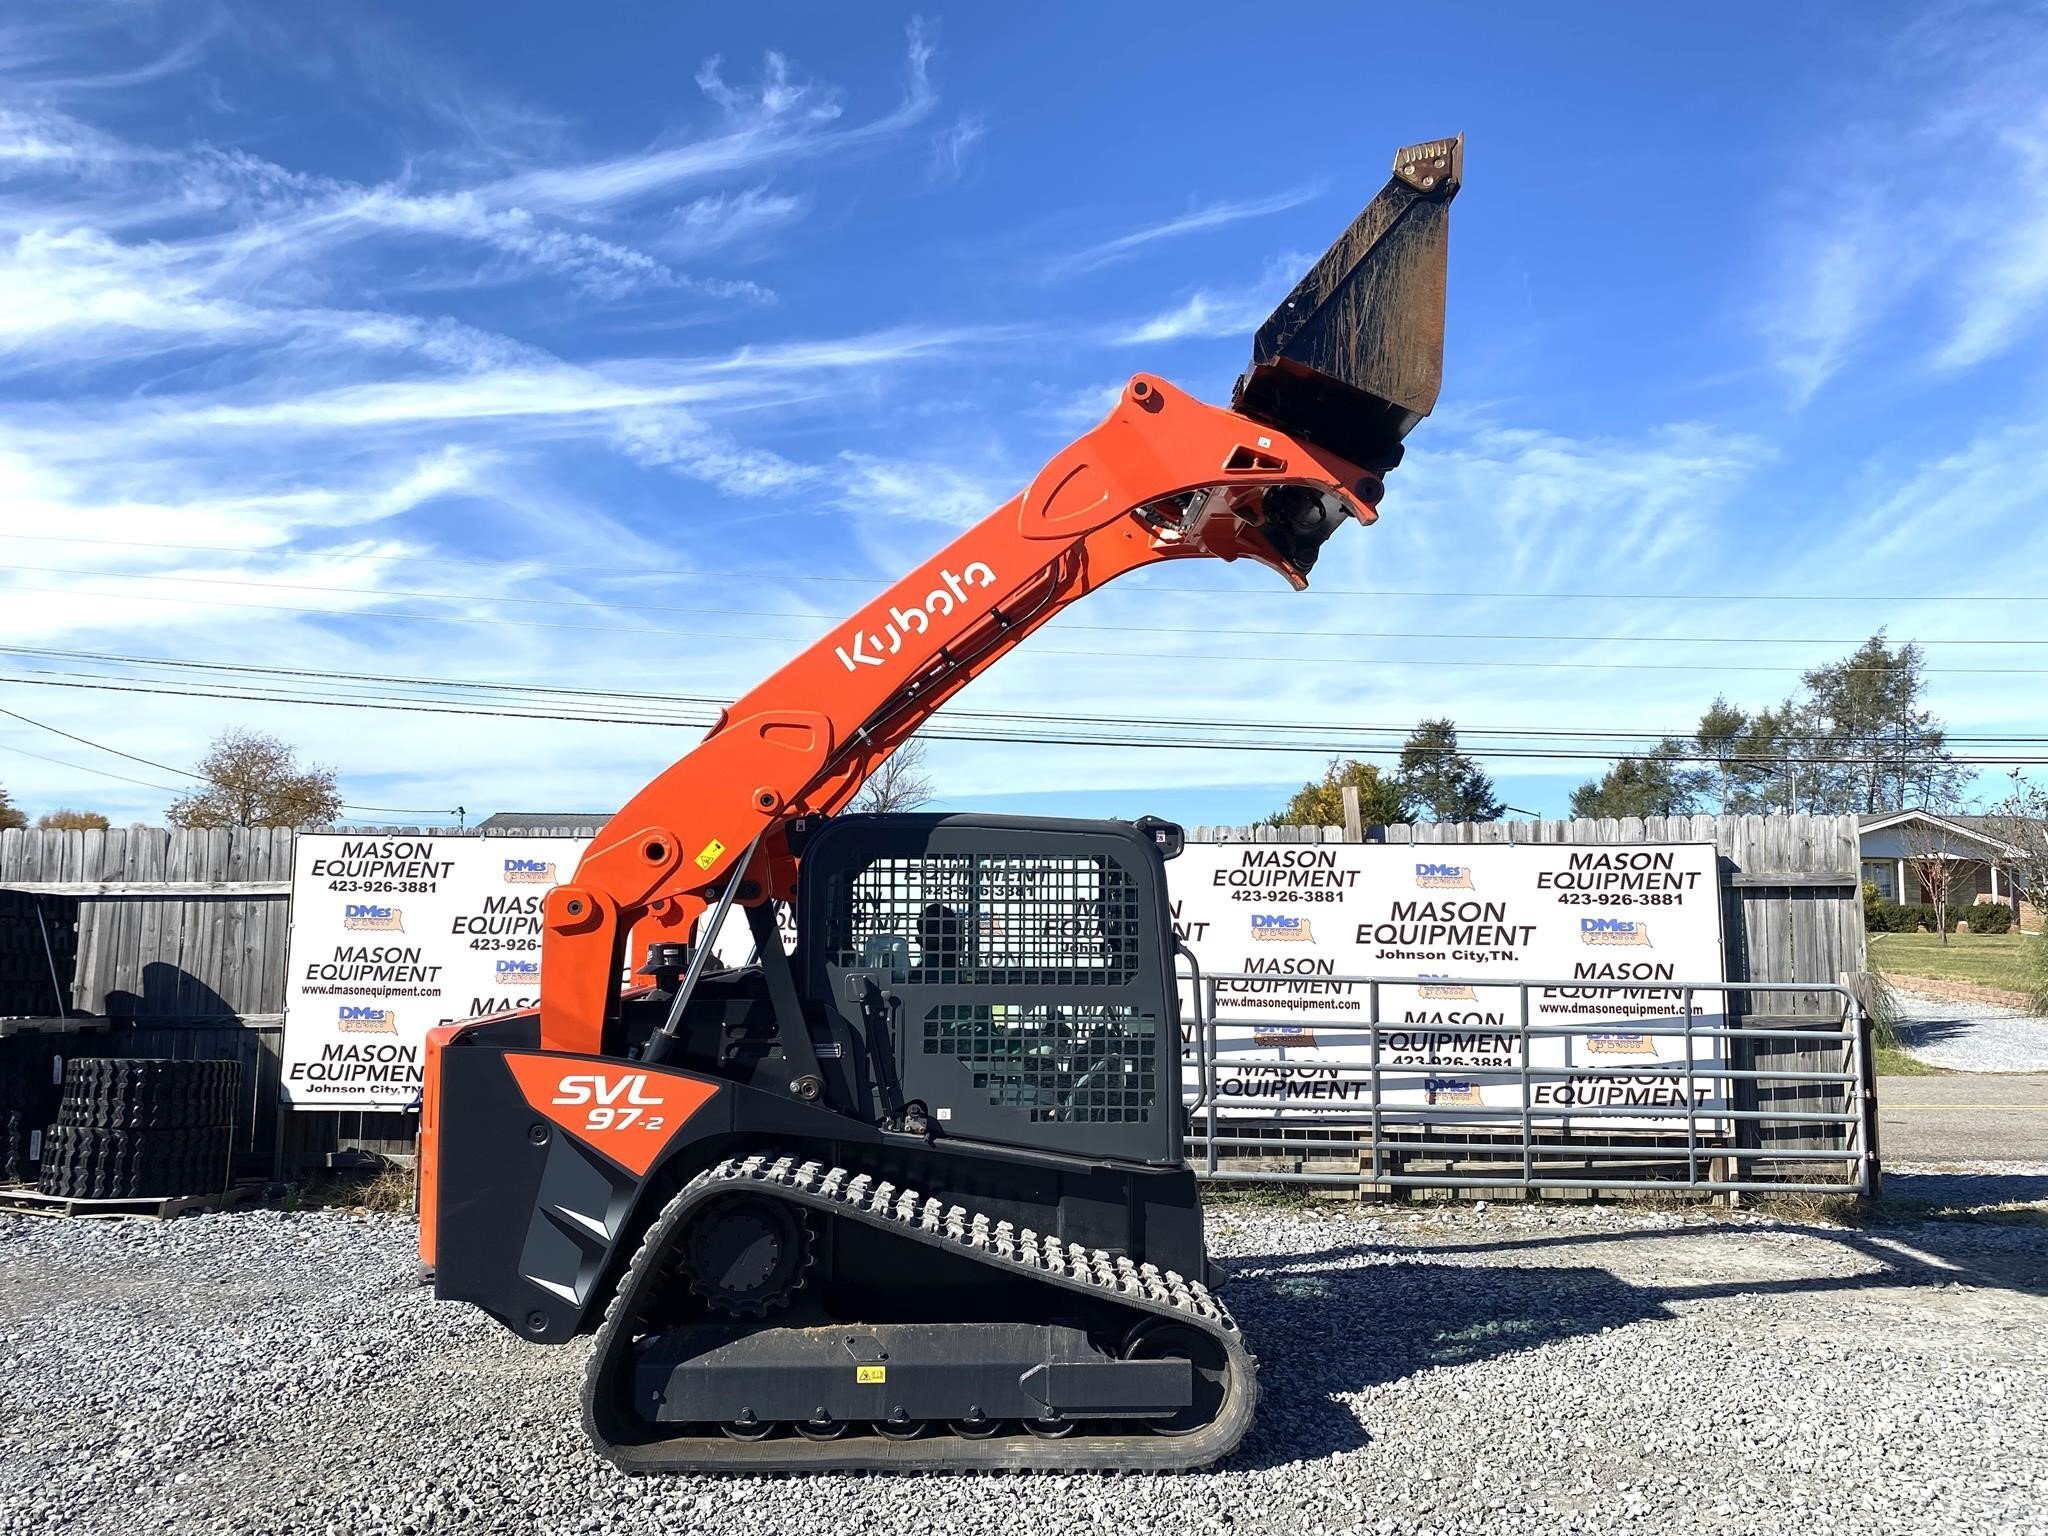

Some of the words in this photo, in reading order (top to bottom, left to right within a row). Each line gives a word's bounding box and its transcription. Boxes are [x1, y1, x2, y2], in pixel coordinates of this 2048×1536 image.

[835, 561, 998, 673] Kubota
[341, 841, 433, 860] MASON
[1242, 850, 1337, 868] MASON
[311, 859, 455, 879] EQUIPMENT
[1568, 852, 1675, 871] MASON
[328, 880, 437, 893] 423-926-3881
[1212, 869, 1361, 888] EQUIPMENT
[1537, 872, 1702, 890] EQUIPMENT
[483, 896, 545, 915] MAS
[1231, 890, 1344, 903] 423-926-3881
[1557, 893, 1684, 906] 423-926-3881
[1390, 901, 1507, 923] MASON
[452, 916, 545, 935] EQUIPM
[1355, 923, 1537, 946] EQUIPMENT
[469, 938, 543, 951] 423-926-
[333, 946, 422, 964] MASON
[1375, 949, 1447, 961] Johnson
[306, 964, 442, 982] EQUIPMENT
[1243, 957, 1335, 976] MASON
[1573, 962, 1675, 981] MASON
[301, 984, 442, 998] www.dmasonequipment.com
[321, 1043, 418, 1063] MASON
[289, 1062, 425, 1082] EQUIPMEN
[305, 1084, 366, 1094] Johnson
[551, 1074, 665, 1105] SVL
[584, 1107, 665, 1131] 97-2
